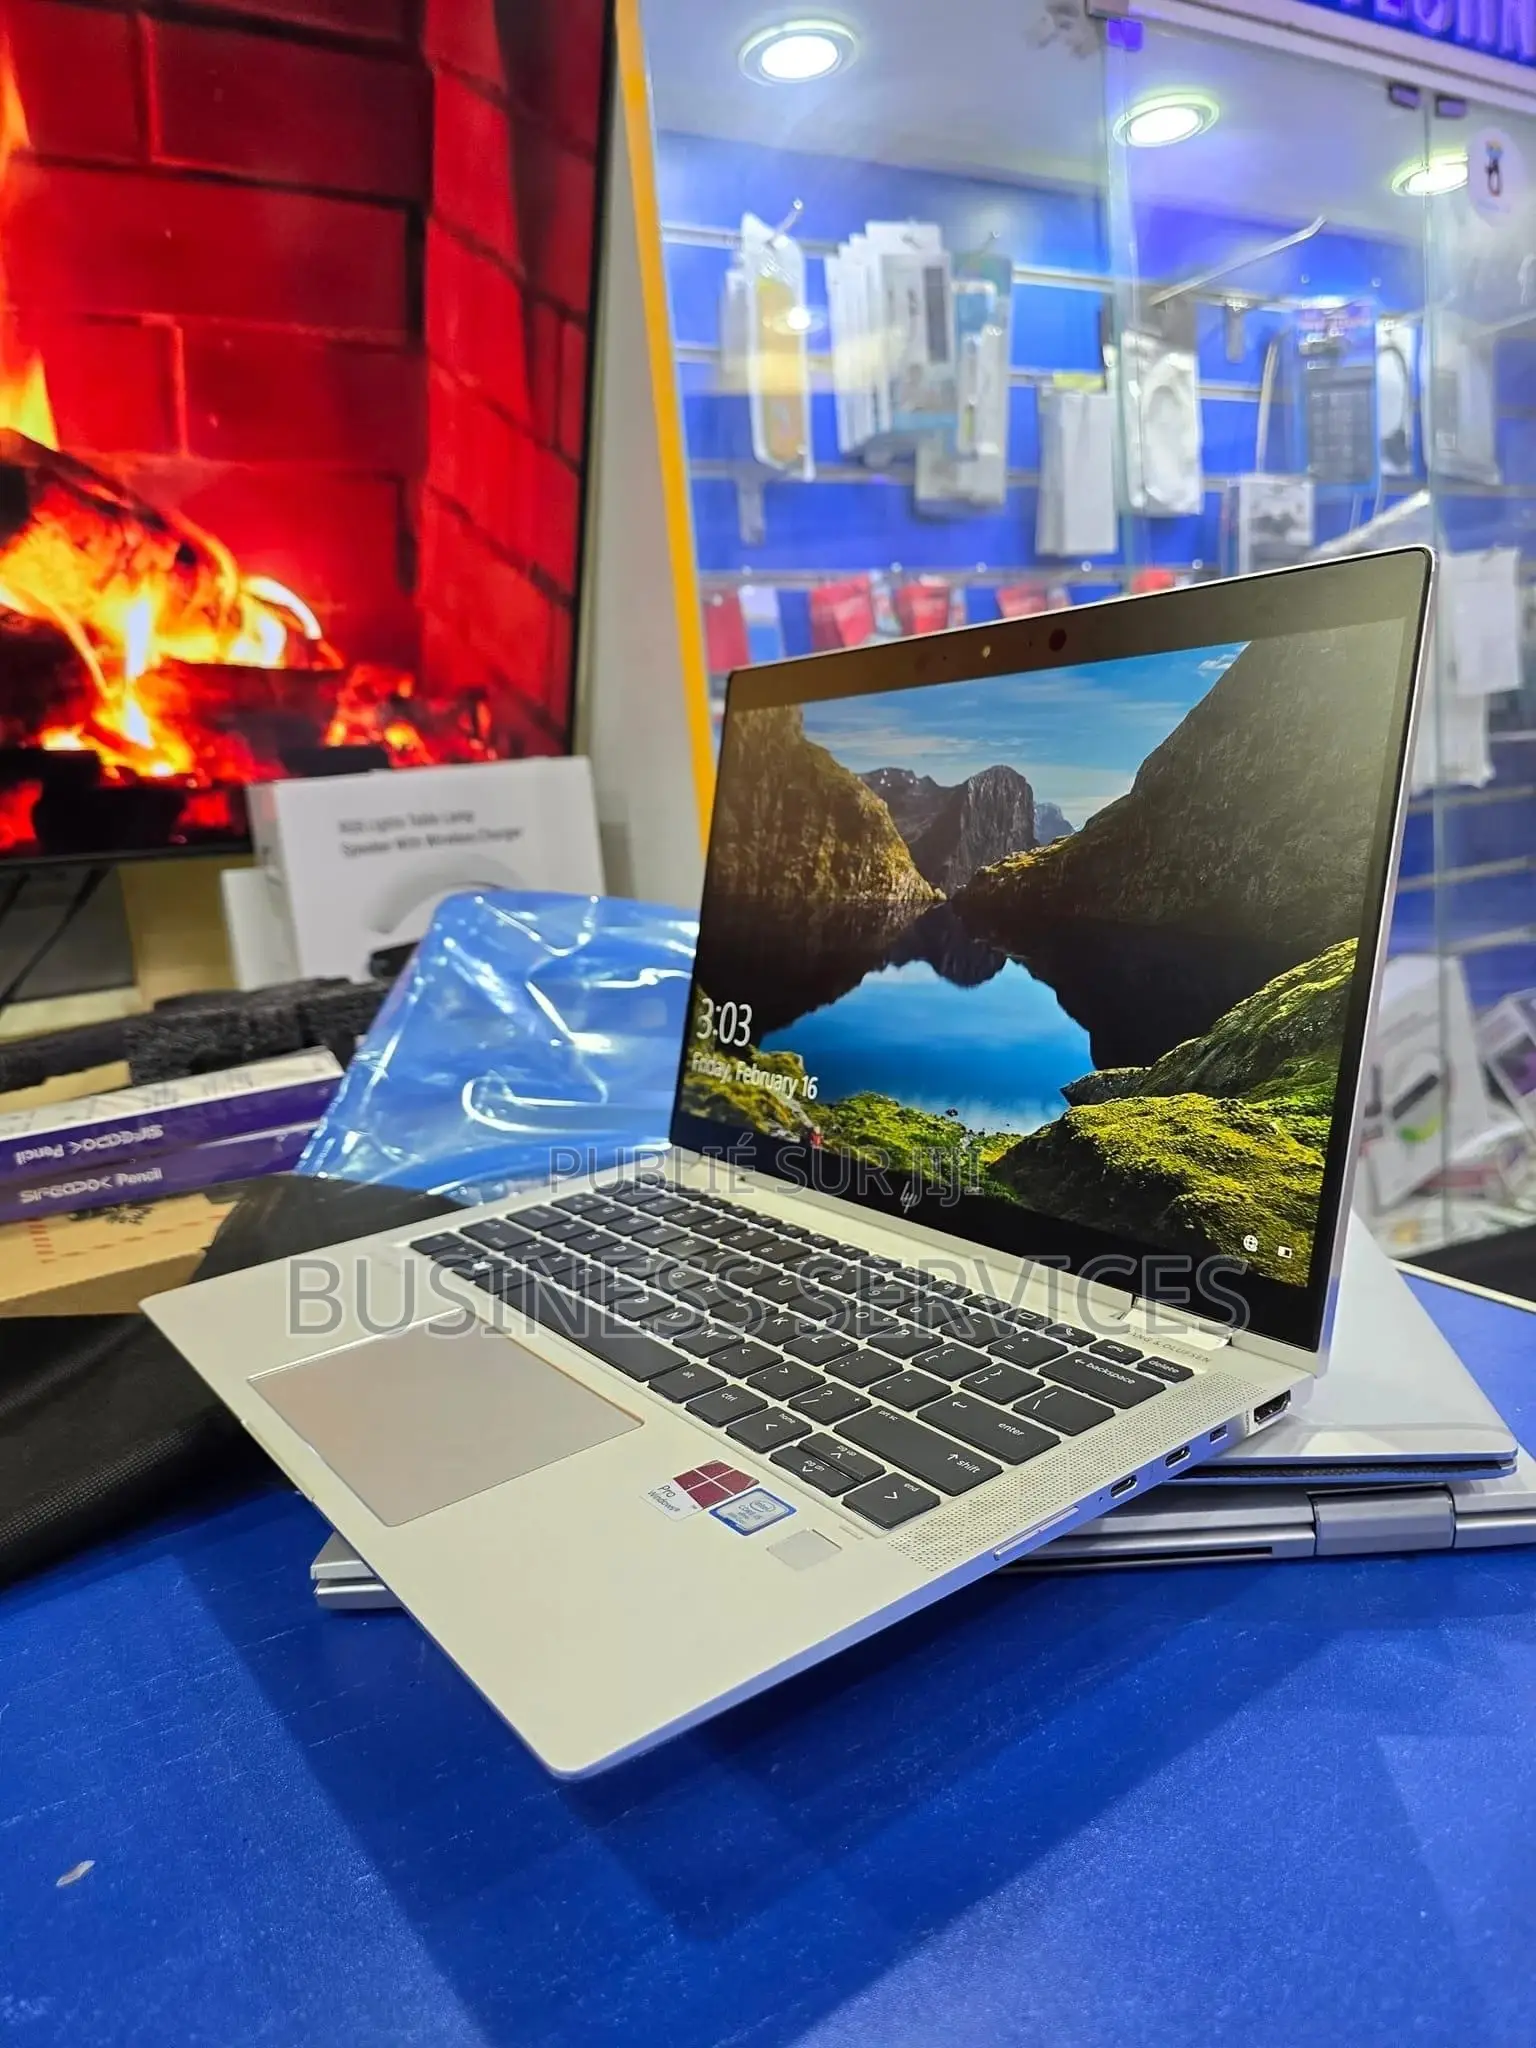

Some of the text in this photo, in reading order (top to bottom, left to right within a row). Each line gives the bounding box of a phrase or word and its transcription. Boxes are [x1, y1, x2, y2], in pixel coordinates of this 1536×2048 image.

[696, 998, 752, 1047] 3:03
[692, 1052, 818, 1099] Friday, February 16
[15, 1143, 65, 1165] Pencil
[114, 1167, 163, 1187] Pencil
[900, 1181, 918, 1214] hp
[1085, 1361, 1137, 1385] backspace
[1148, 1359, 1180, 1374] delete
[721, 1392, 739, 1403] ctrl
[778, 1412, 797, 1425] home
[998, 1421, 1026, 1438] enter
[957, 1458, 982, 1475] shift
[657, 1485, 677, 1498] Pro
[903, 1482, 921, 1493] end
[647, 1489, 681, 1512] Windows
